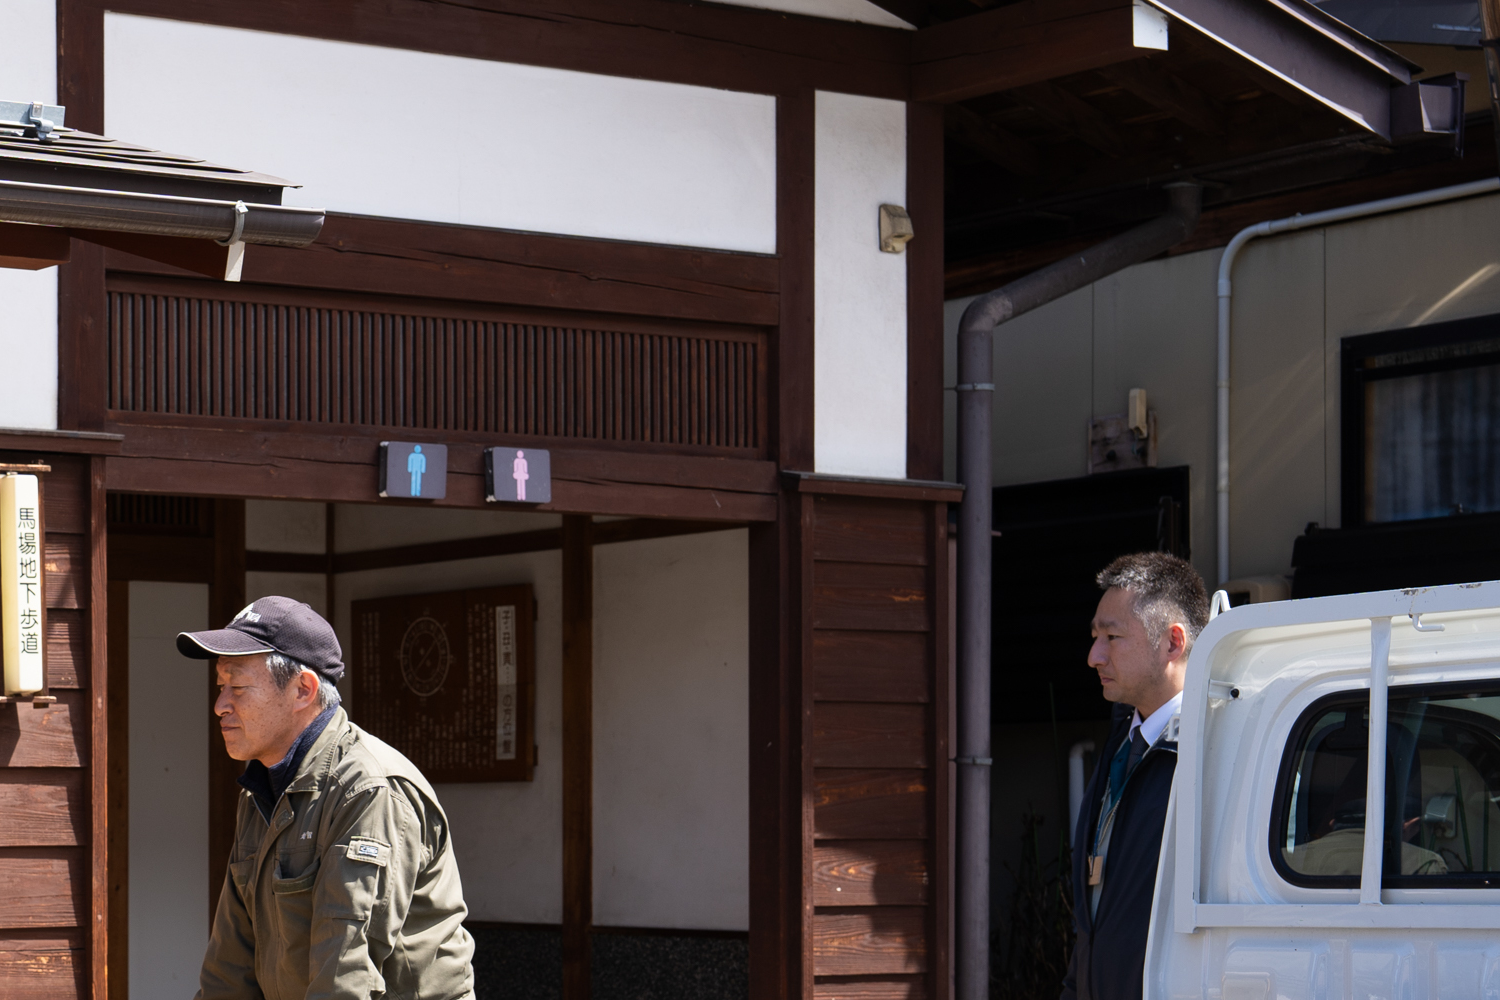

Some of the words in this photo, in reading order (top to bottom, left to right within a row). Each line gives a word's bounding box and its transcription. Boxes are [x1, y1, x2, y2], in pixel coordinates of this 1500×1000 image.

[18, 507, 38, 654] 馬場地下歩道
